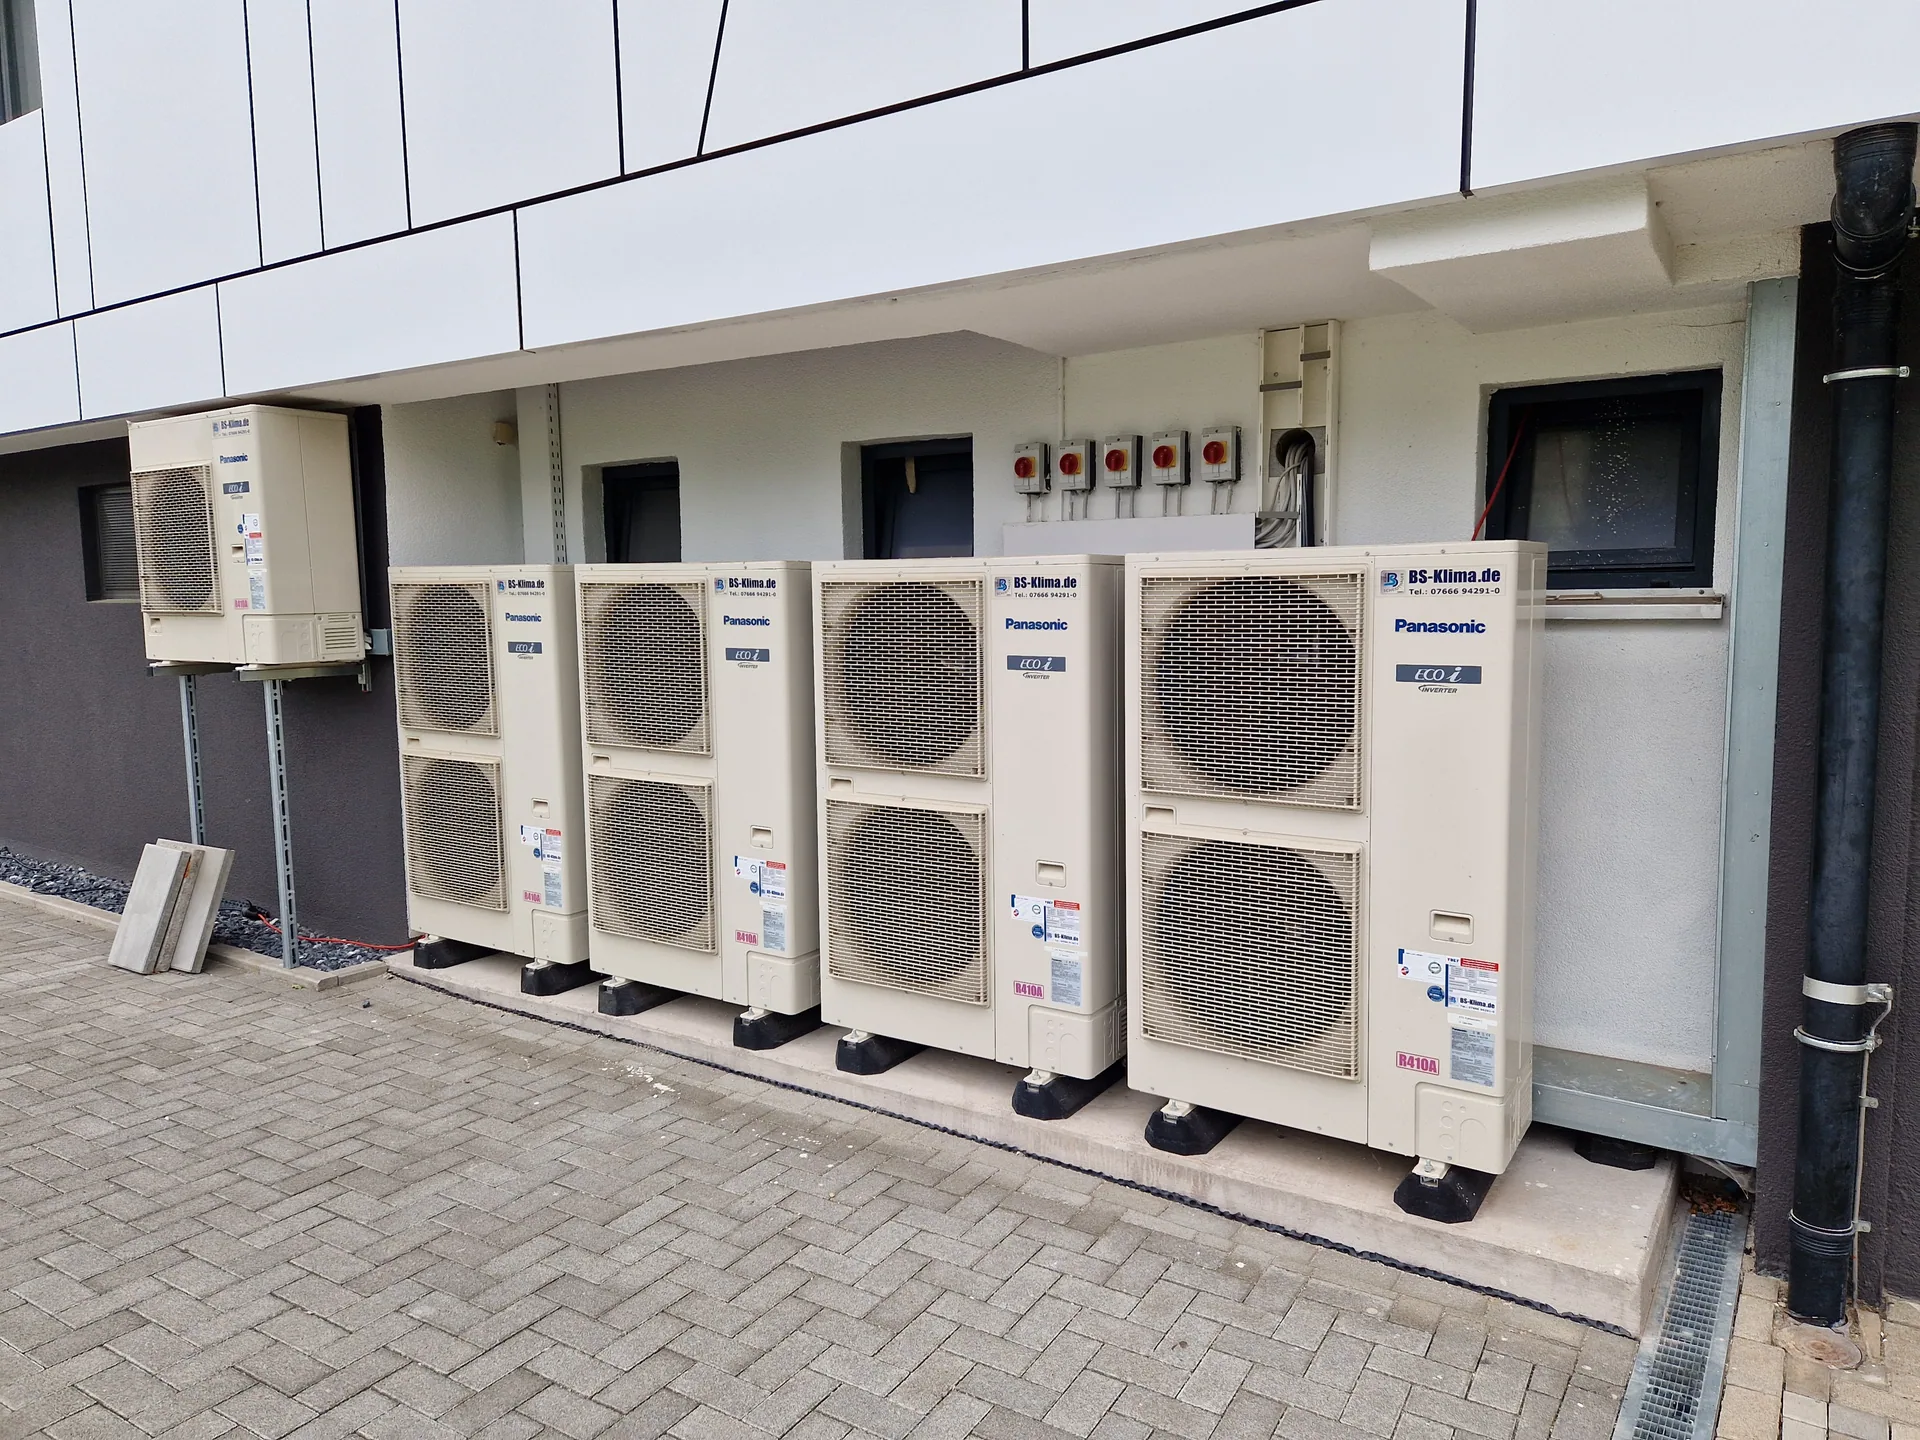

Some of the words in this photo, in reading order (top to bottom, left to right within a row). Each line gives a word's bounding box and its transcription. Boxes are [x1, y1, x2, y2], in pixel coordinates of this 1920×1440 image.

[220, 453, 249, 464] Panasonic
[1014, 576, 1076, 588] BS-Klima.de
[1409, 568, 1501, 584] BS-Klima.de
[508, 580, 544, 588] BS-Klima.de
[729, 578, 776, 589] BS-Klima.de
[506, 612, 542, 622] Panasonic
[724, 615, 770, 626] Panasonic
[1006, 618, 1068, 630] Panasonic
[1395, 619, 1486, 633] Panasonic
[516, 644, 527, 652] ECO
[736, 651, 751, 660] ECO
[752, 649, 760, 661] i
[1020, 659, 1041, 669] ECO
[1042, 657, 1052, 670] i
[1415, 668, 1444, 681] ECO
[1446, 667, 1462, 683] i
[1420, 686, 1458, 694] INVERTER
[737, 931, 757, 944] R410A
[1016, 982, 1043, 997] R410A
[1460, 997, 1495, 1009] BS-Klima.de
[1398, 1054, 1438, 1073] R410A
